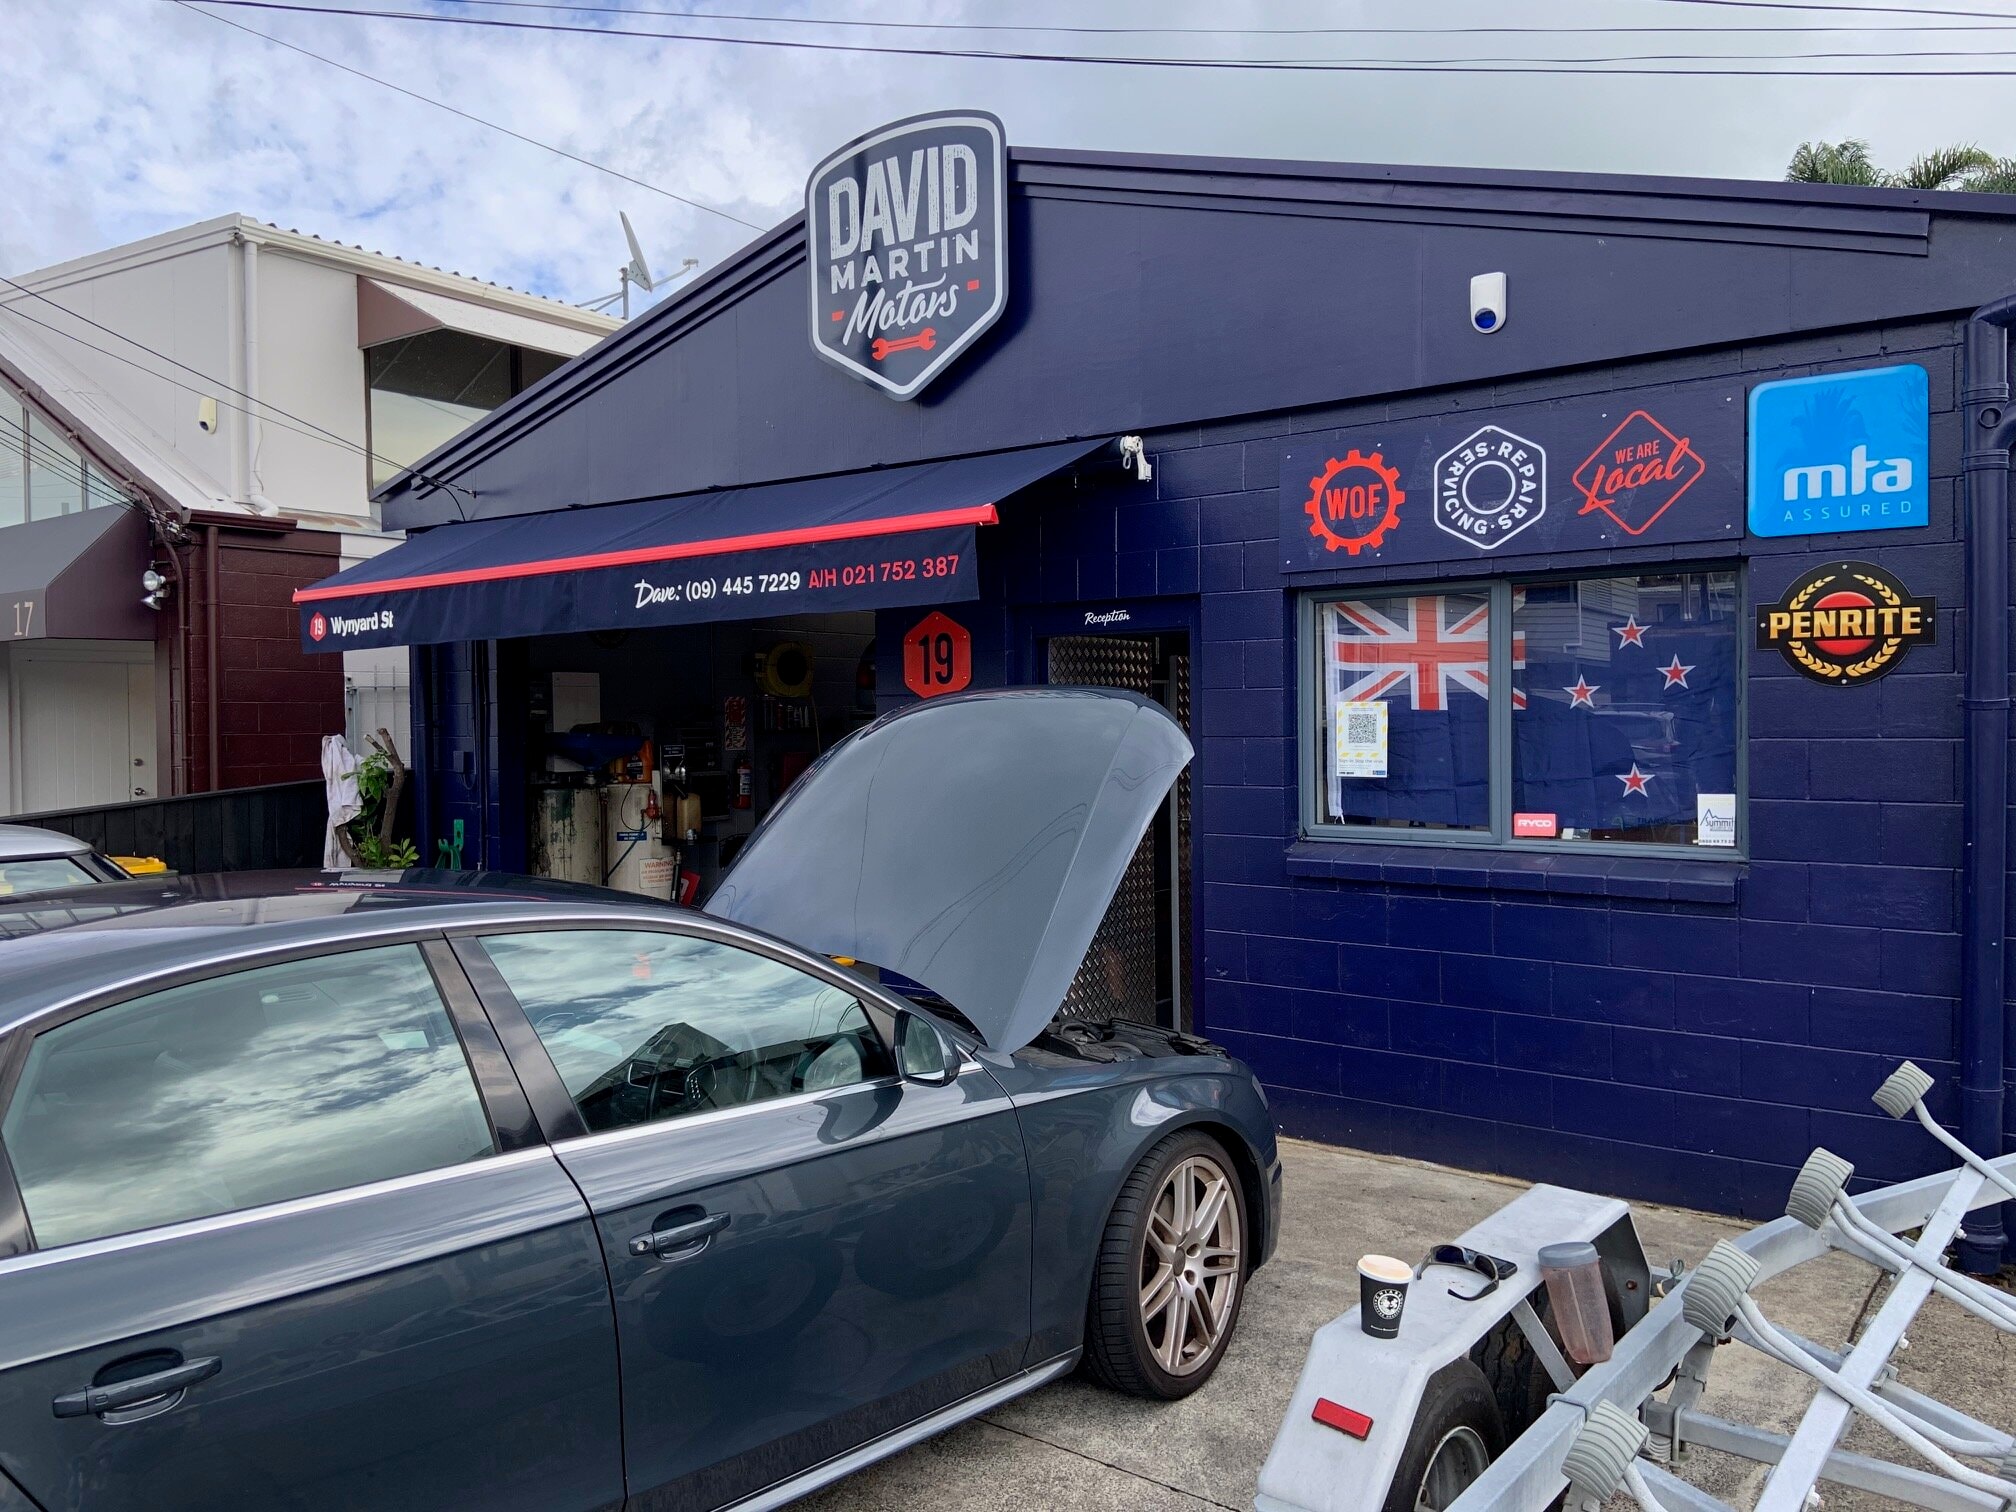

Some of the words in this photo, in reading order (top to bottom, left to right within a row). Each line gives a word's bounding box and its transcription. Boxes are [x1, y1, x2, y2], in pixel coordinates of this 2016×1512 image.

[828, 143, 978, 261] DAVID
[830, 228, 979, 294] MARTIN
[842, 272, 959, 346] Motors
[1615, 447, 1634, 464] WE
[1635, 440, 1660, 461] ARE
[1783, 444, 1913, 501] mta
[1442, 441, 1489, 535] SERVICING
[1496, 441, 1536, 531] REPAIRS
[1577, 437, 1690, 516] Local
[1326, 483, 1383, 521] WOF
[1783, 501, 1912, 522] ASSURED
[634, 578, 682, 609] Dave:
[685, 578, 717, 602] (09)
[722, 576, 753, 595] 445
[758, 571, 800, 593] 7229
[808, 567, 837, 589] A/H
[842, 563, 875, 587] 021
[880, 560, 916, 582] 752
[922, 555, 959, 578] 387
[13, 601, 34, 637] 17
[314, 617, 322, 635] 19
[330, 612, 379, 636] Wynyard
[381, 611, 394, 628] St
[1084, 609, 1131, 627] Reception
[1769, 606, 1922, 639] PENRITE
[918, 632, 954, 685] 19
[1517, 819, 1552, 828] RYCO
[1705, 816, 1735, 827] Summit
